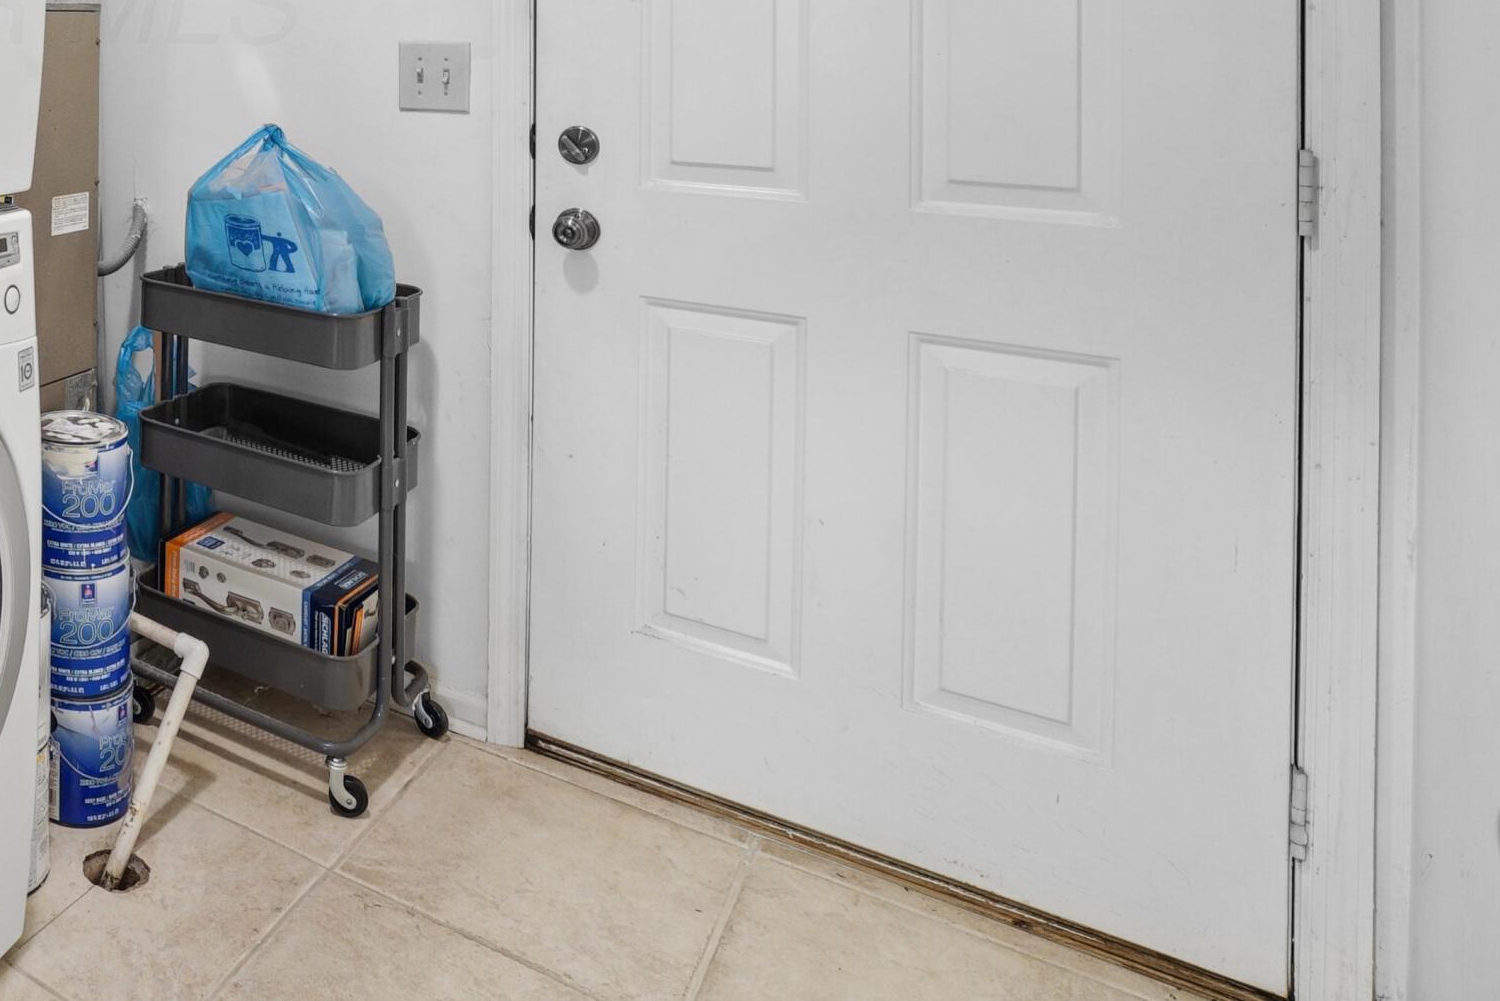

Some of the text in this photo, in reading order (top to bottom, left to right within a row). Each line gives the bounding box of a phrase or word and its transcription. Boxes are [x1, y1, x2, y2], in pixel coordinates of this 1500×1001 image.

[62, 492, 116, 518] 200
[60, 606, 114, 622] ProMar
[60, 619, 114, 645] 200
[321, 612, 329, 655] SCHLAG
